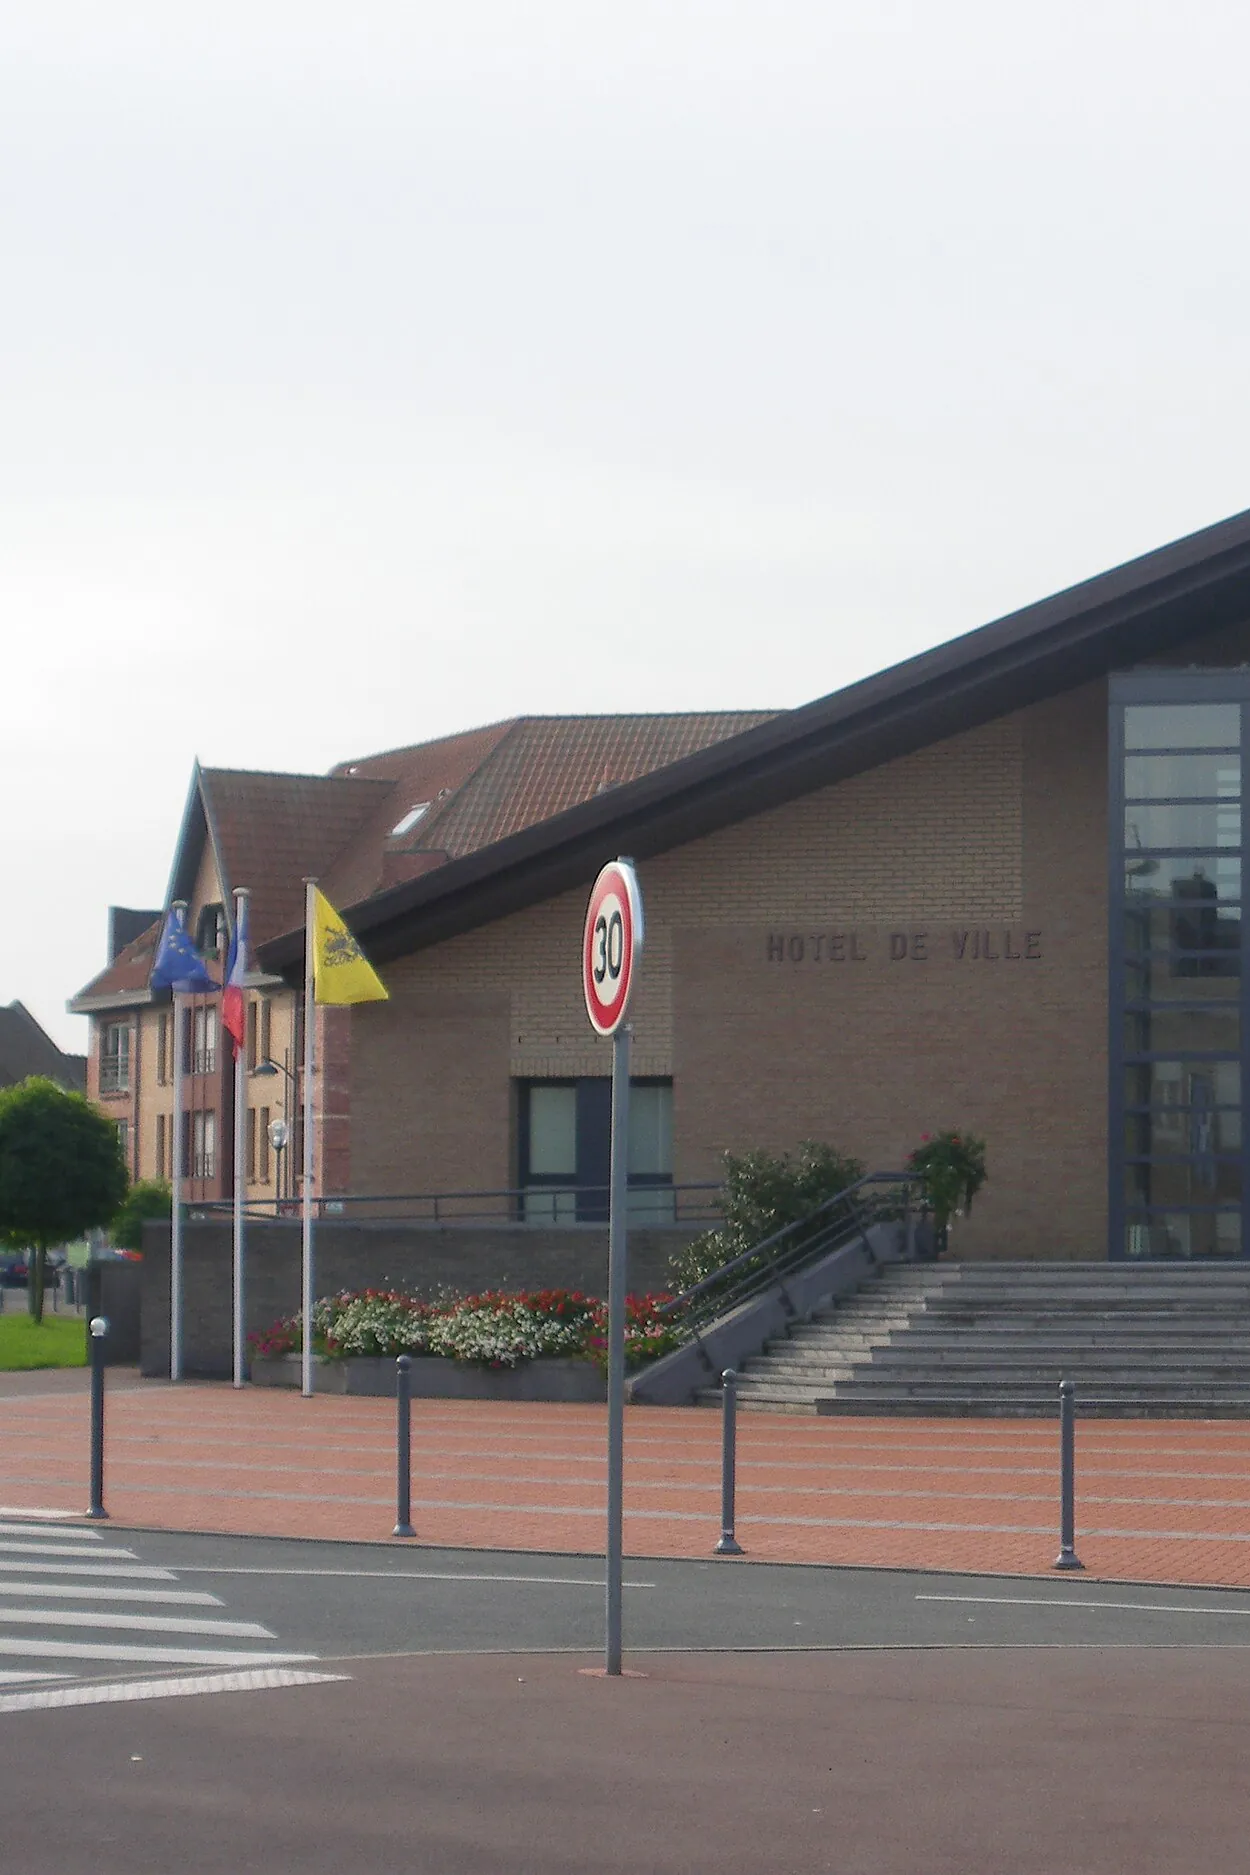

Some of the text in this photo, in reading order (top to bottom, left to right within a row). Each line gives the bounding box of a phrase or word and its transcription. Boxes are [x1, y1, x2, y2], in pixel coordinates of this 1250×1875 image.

[594, 910, 623, 983] 30
[767, 931, 1043, 962] HOTEL DE VILLE
